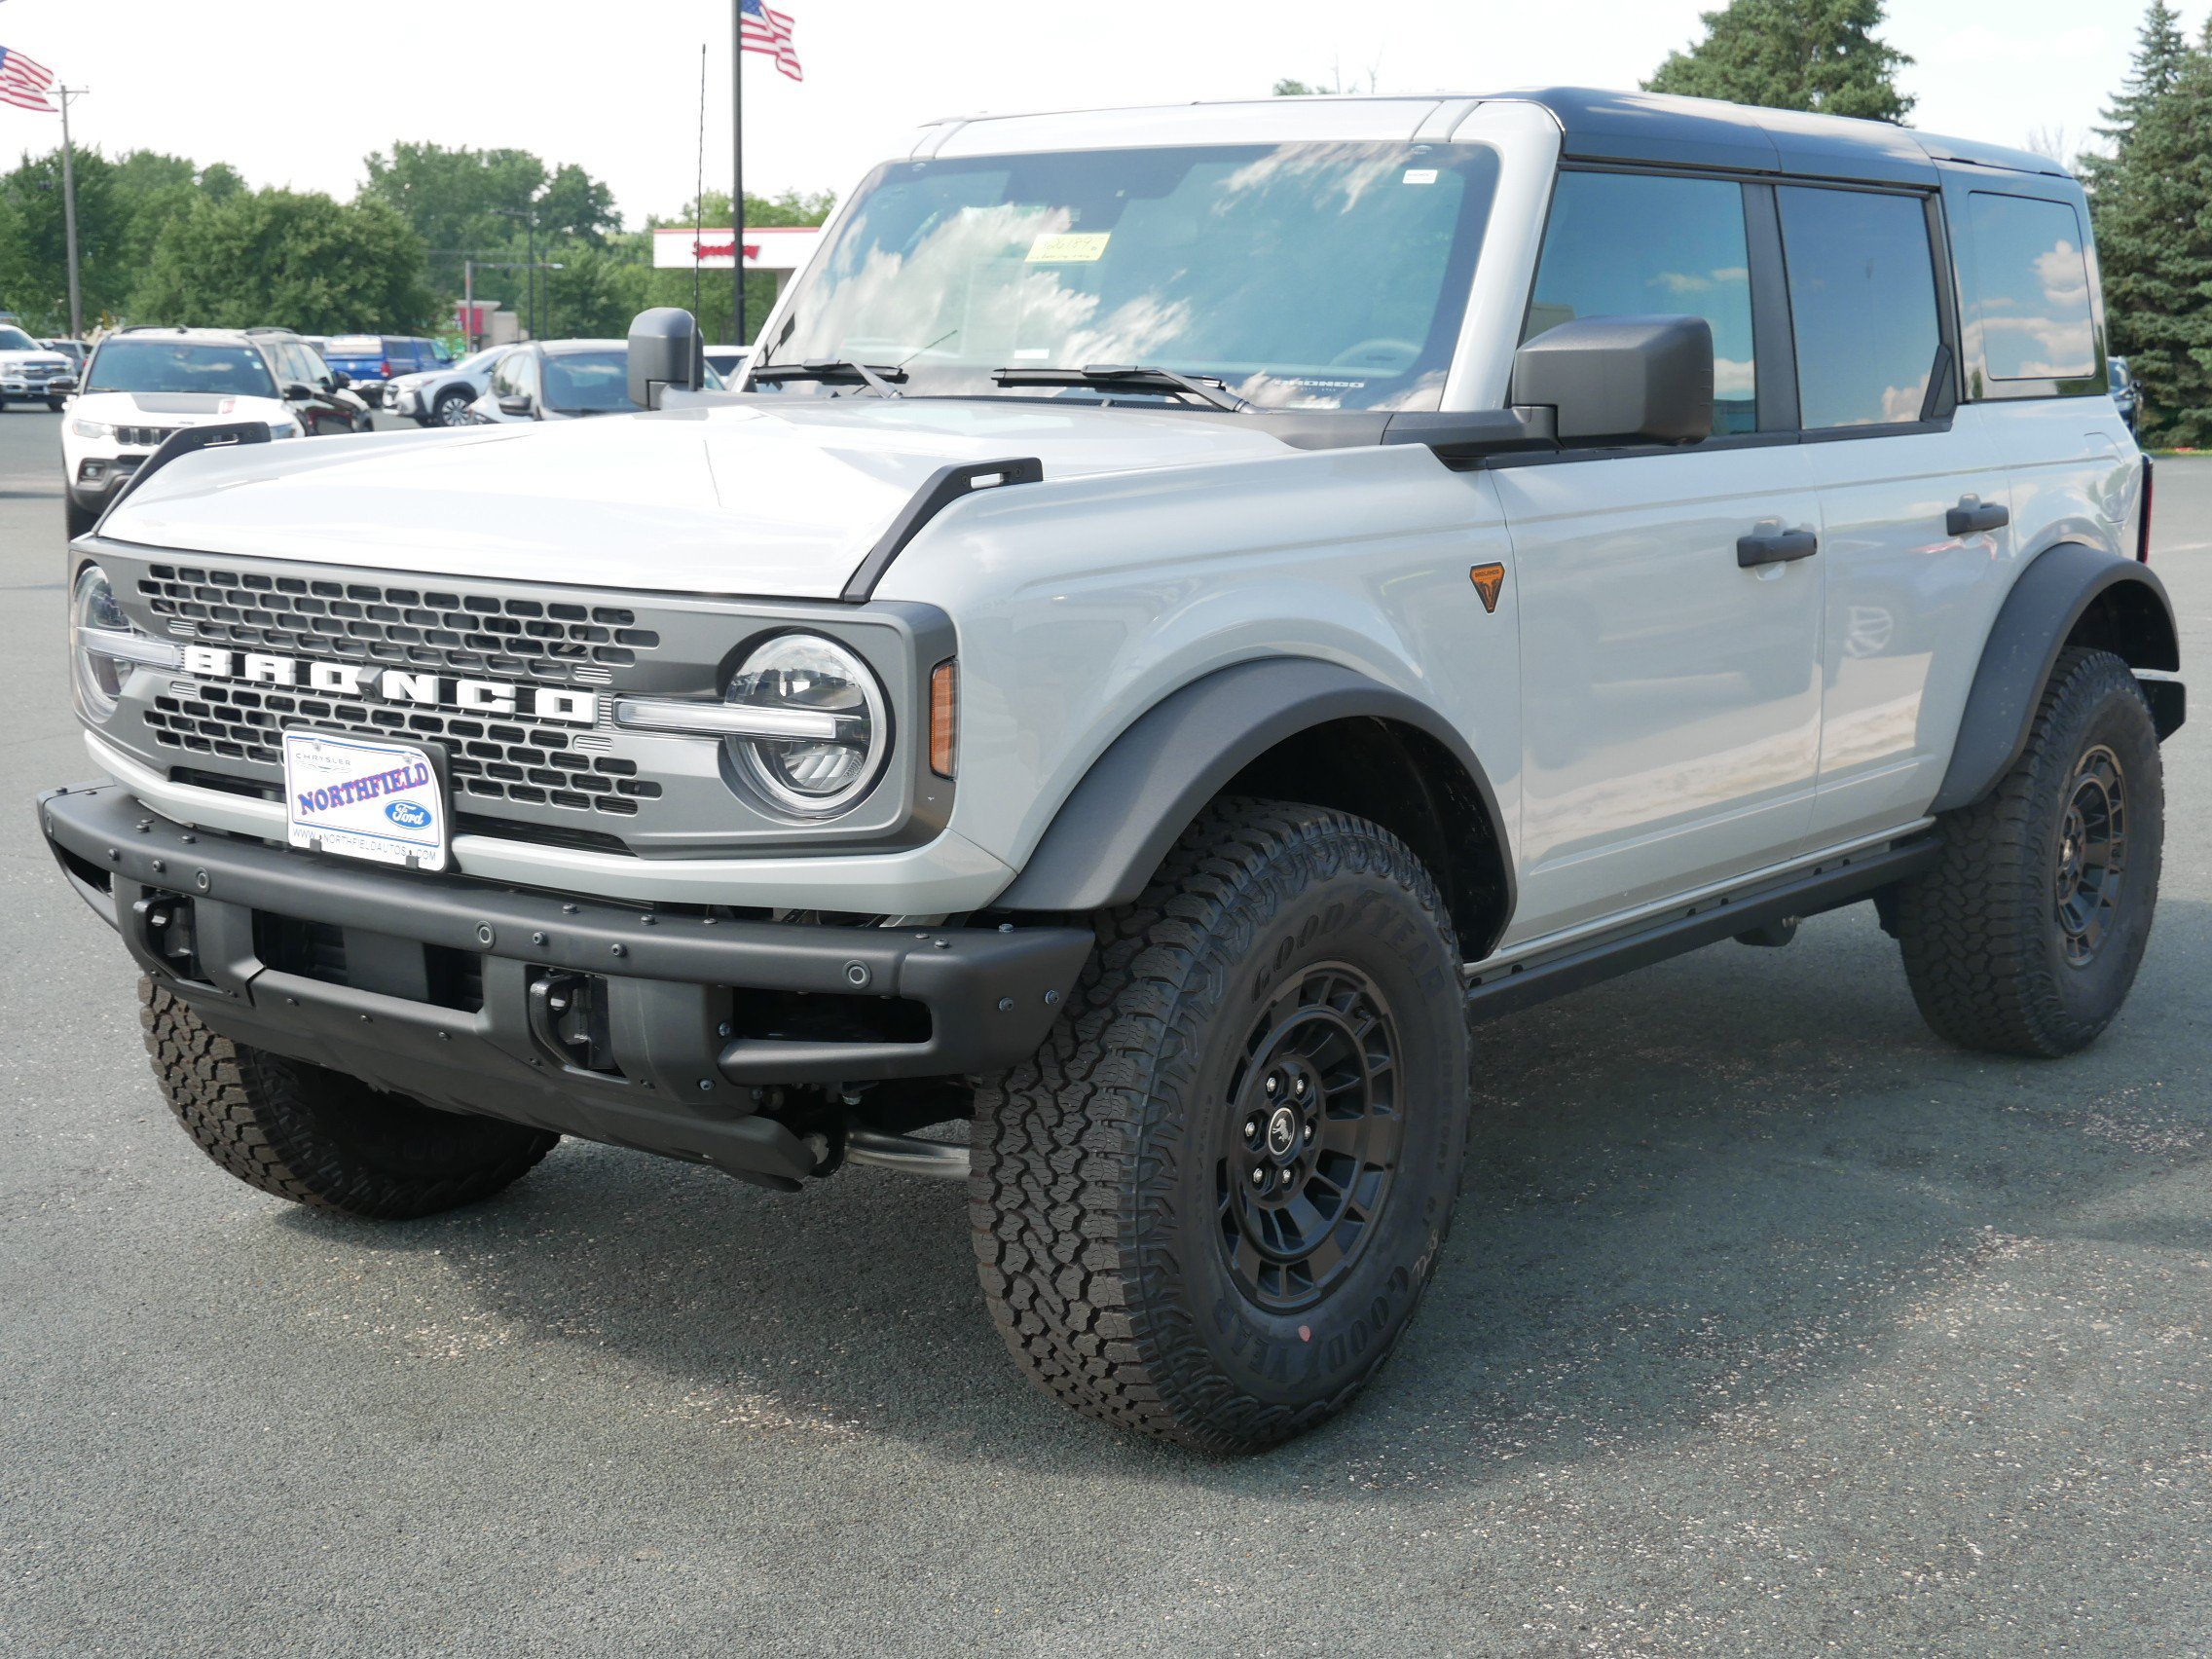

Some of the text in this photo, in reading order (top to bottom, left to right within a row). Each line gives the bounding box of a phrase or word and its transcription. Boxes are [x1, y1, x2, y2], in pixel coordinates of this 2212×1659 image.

[184, 645, 600, 723] BRONCO
[295, 752, 352, 766] CHRYSLER
[297, 762, 430, 816] NORTHFIELD
[391, 802, 425, 827] Ford
